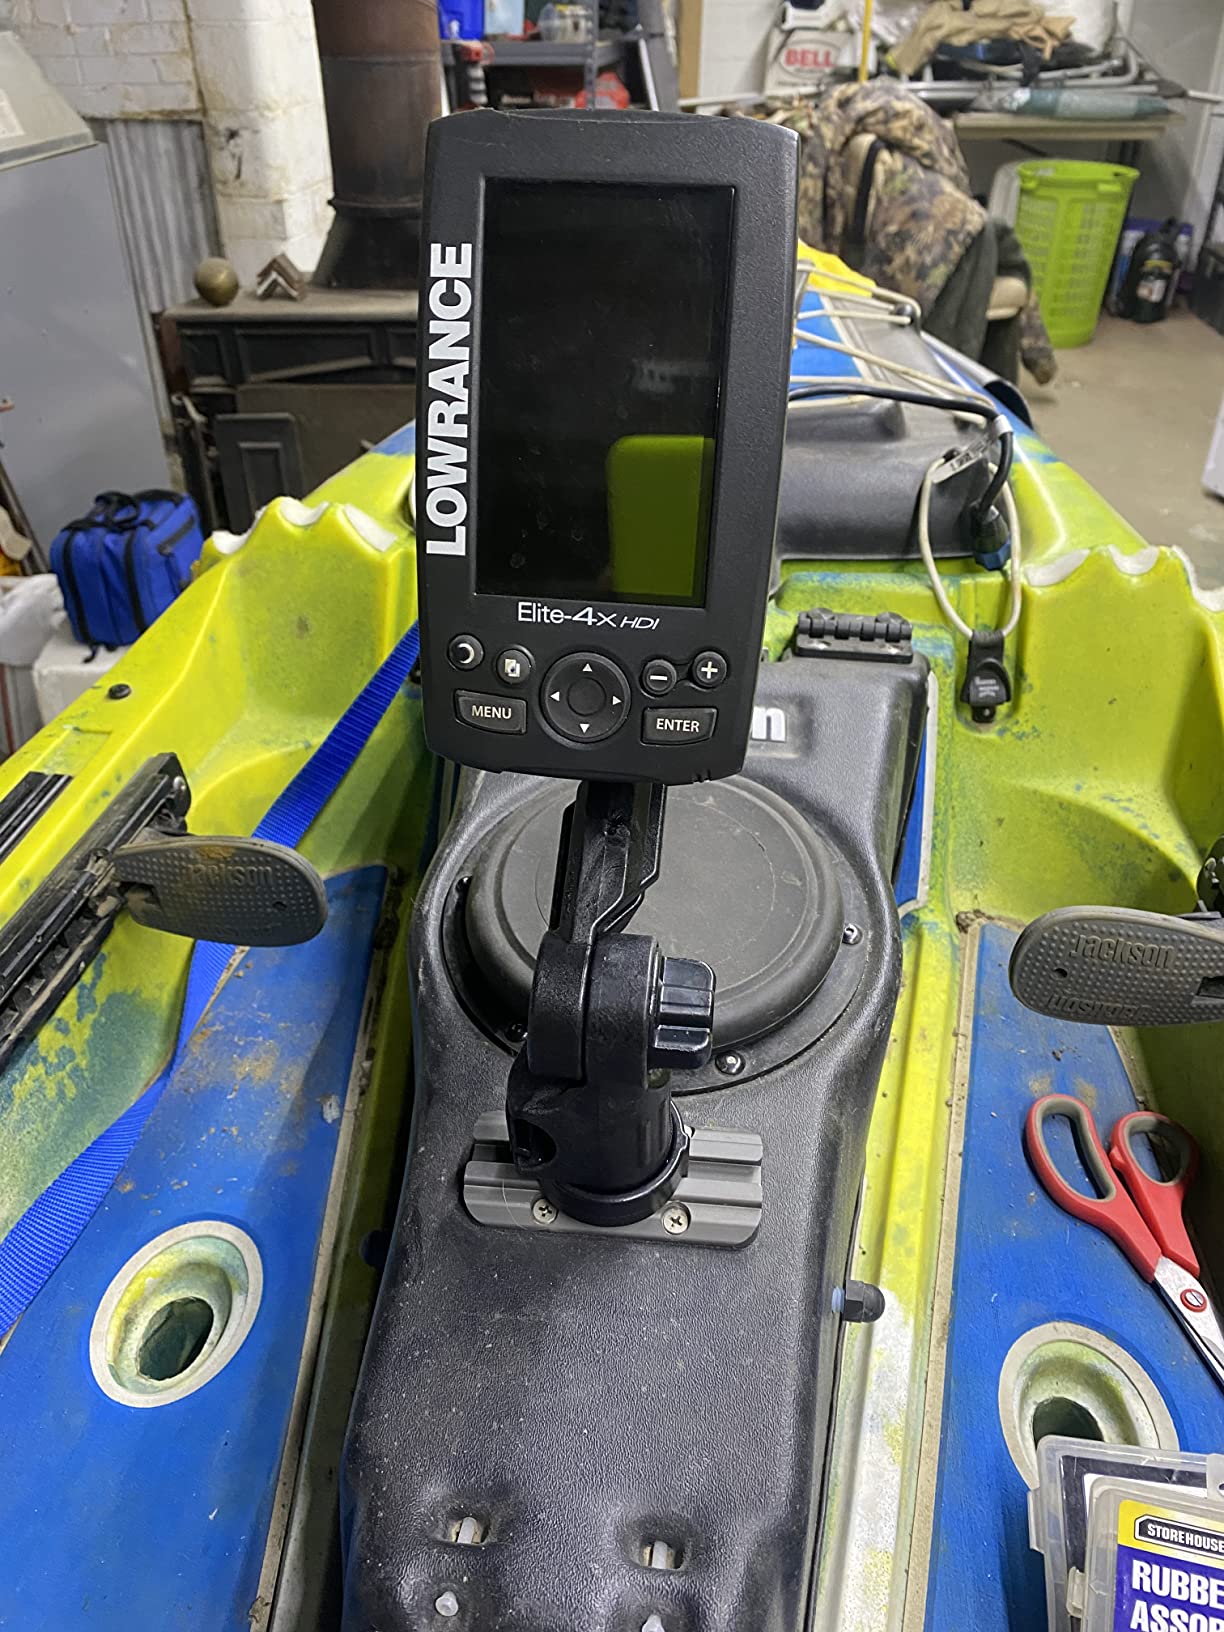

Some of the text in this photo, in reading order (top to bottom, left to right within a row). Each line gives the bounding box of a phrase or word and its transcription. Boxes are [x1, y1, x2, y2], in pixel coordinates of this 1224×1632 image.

[785, 47, 836, 69] BELL
[426, 243, 472, 556] LOWRANCE
[620, 616, 660, 630] HDI
[471, 704, 512, 720] MENU
[655, 717, 700, 733] ENTER
[1069, 934, 1175, 969] Jackson
[1147, 1523, 1224, 1553] STOREHOUSE
[1131, 1559, 1224, 1611] RUBBE
